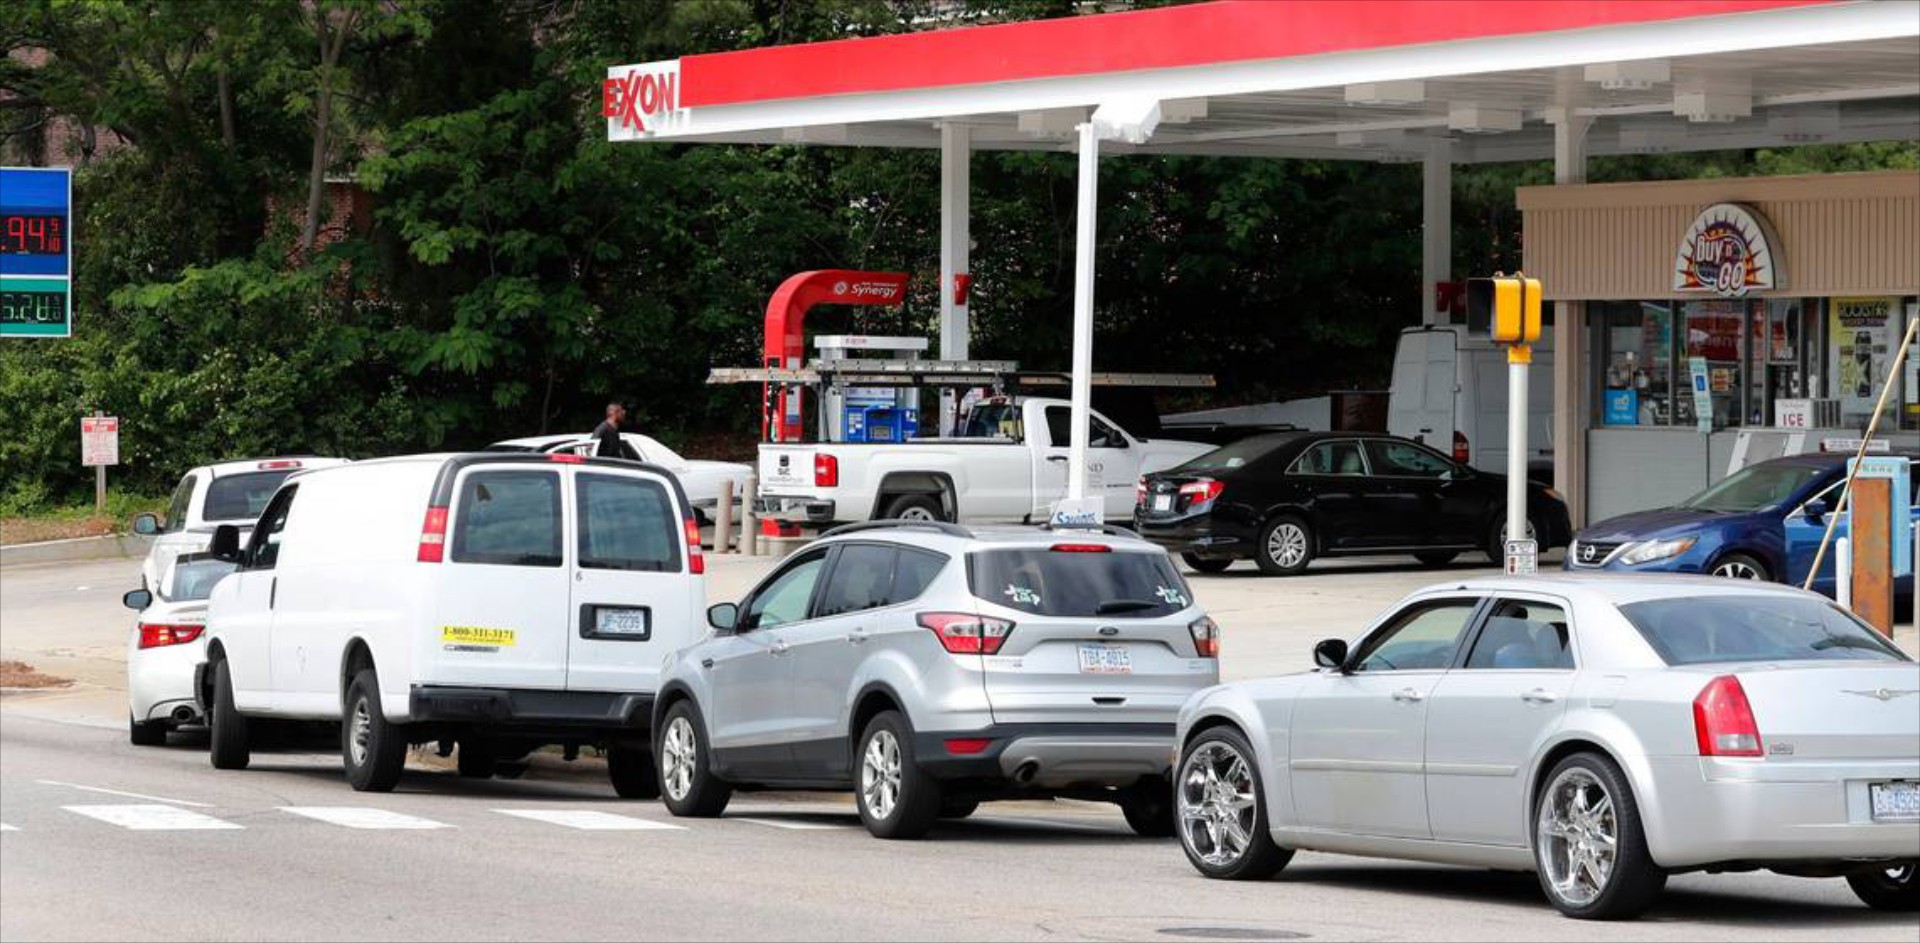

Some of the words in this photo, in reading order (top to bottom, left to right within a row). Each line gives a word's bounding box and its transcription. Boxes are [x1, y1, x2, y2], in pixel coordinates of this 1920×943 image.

[603, 69, 675, 132] EXXON
[1696, 234, 1724, 264] Buy
[1719, 261, 1745, 289] GO
[851, 283, 897, 299] Synergy
[1783, 413, 1804, 427] ICE
